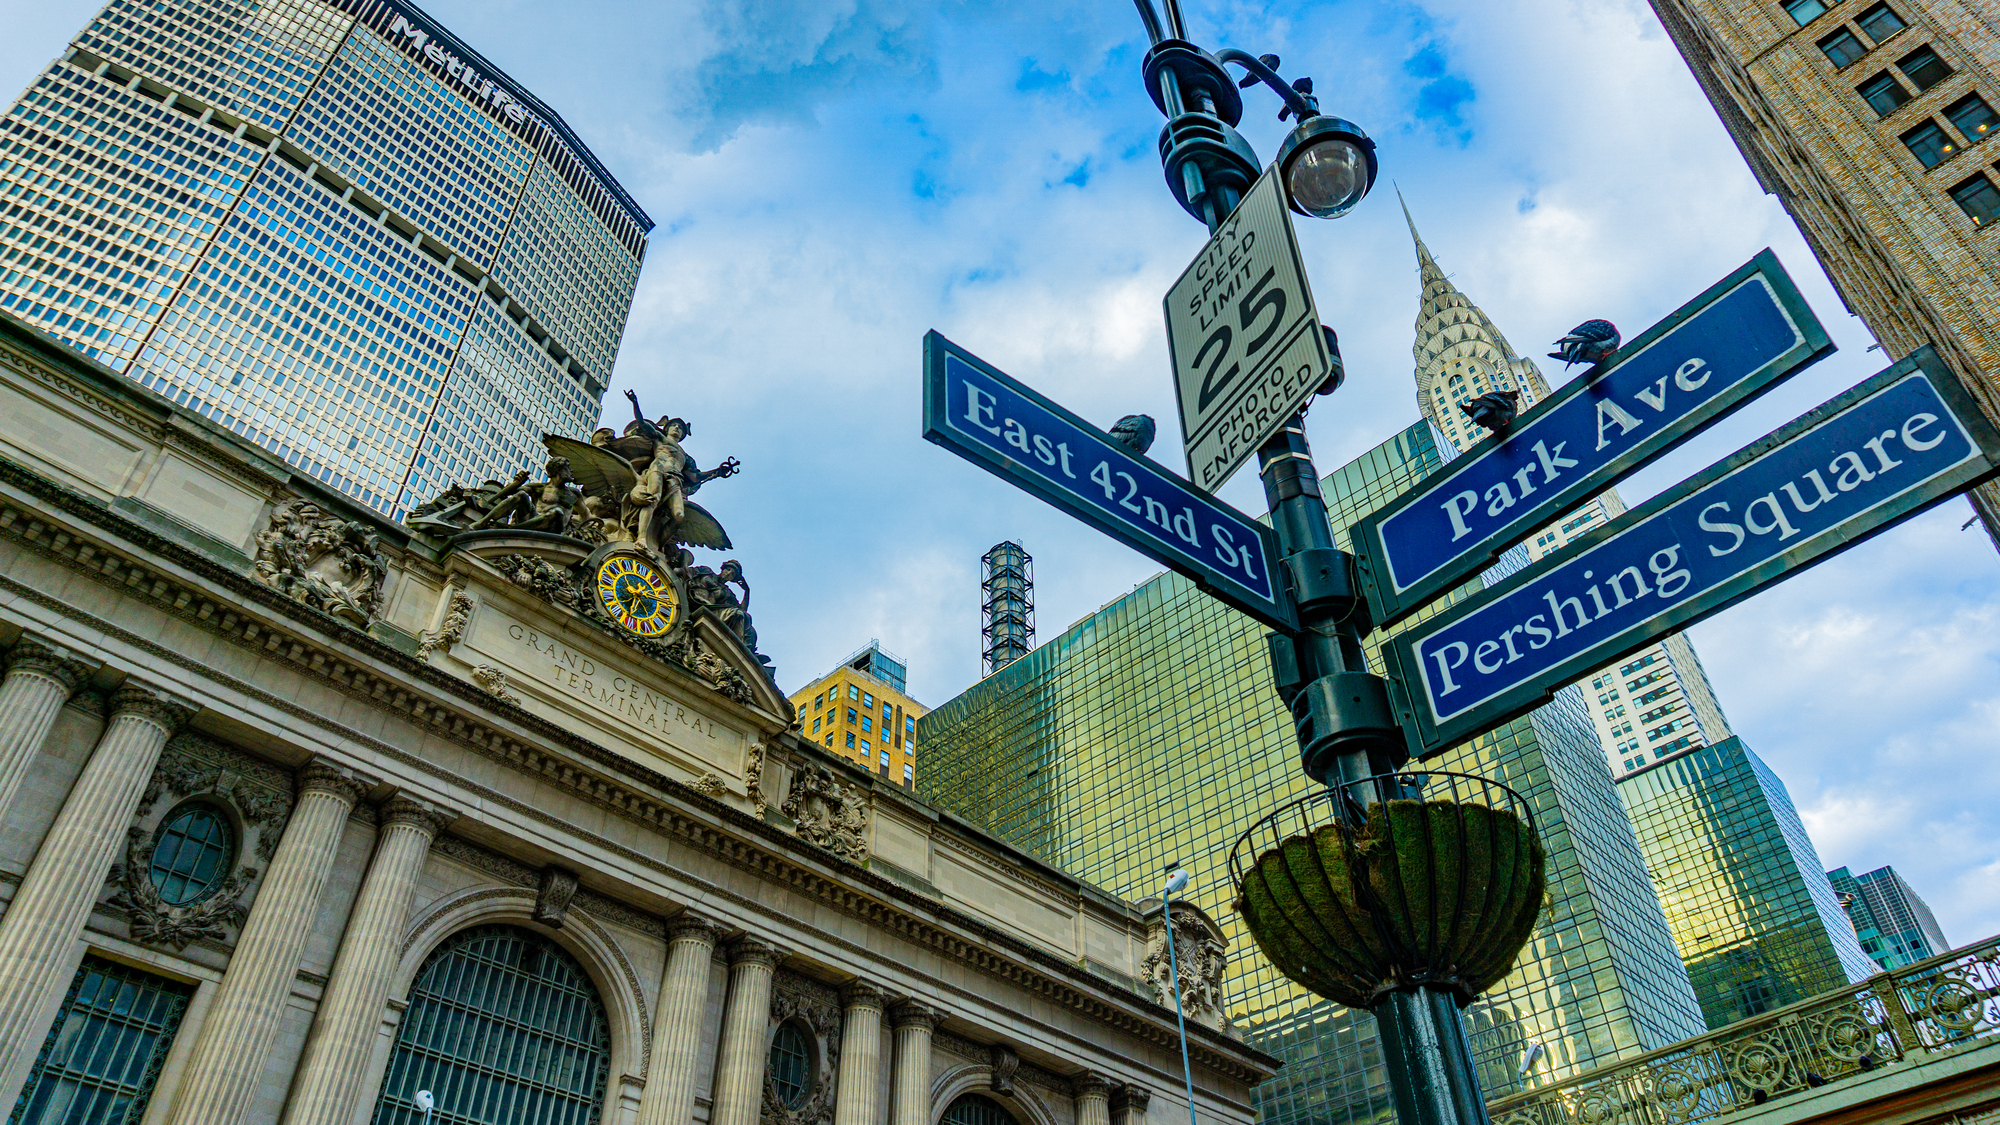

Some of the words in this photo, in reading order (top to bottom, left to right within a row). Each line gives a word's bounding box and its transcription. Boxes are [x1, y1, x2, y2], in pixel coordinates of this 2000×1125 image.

[390, 15, 525, 124] MetLife
[1189, 230, 1256, 317] SPEED
[1195, 218, 1242, 282] CITY
[1199, 257, 1253, 333] LIMIT
[1191, 264, 1287, 415] 25
[1203, 363, 1312, 486] ENFORCED
[1217, 365, 1284, 445] PHOTO
[1440, 440, 1579, 543] Park
[1594, 356, 1713, 451] Ave
[962, 379, 1077, 479] East
[1090, 460, 1202, 548] 42nd
[1210, 523, 1258, 580] St
[1429, 543, 1692, 698] Pershing
[1697, 411, 1947, 558] Square
[508, 624, 595, 676] GRAND
[613, 677, 717, 739] CENTRAL
[553, 664, 672, 735] TERMINAL
